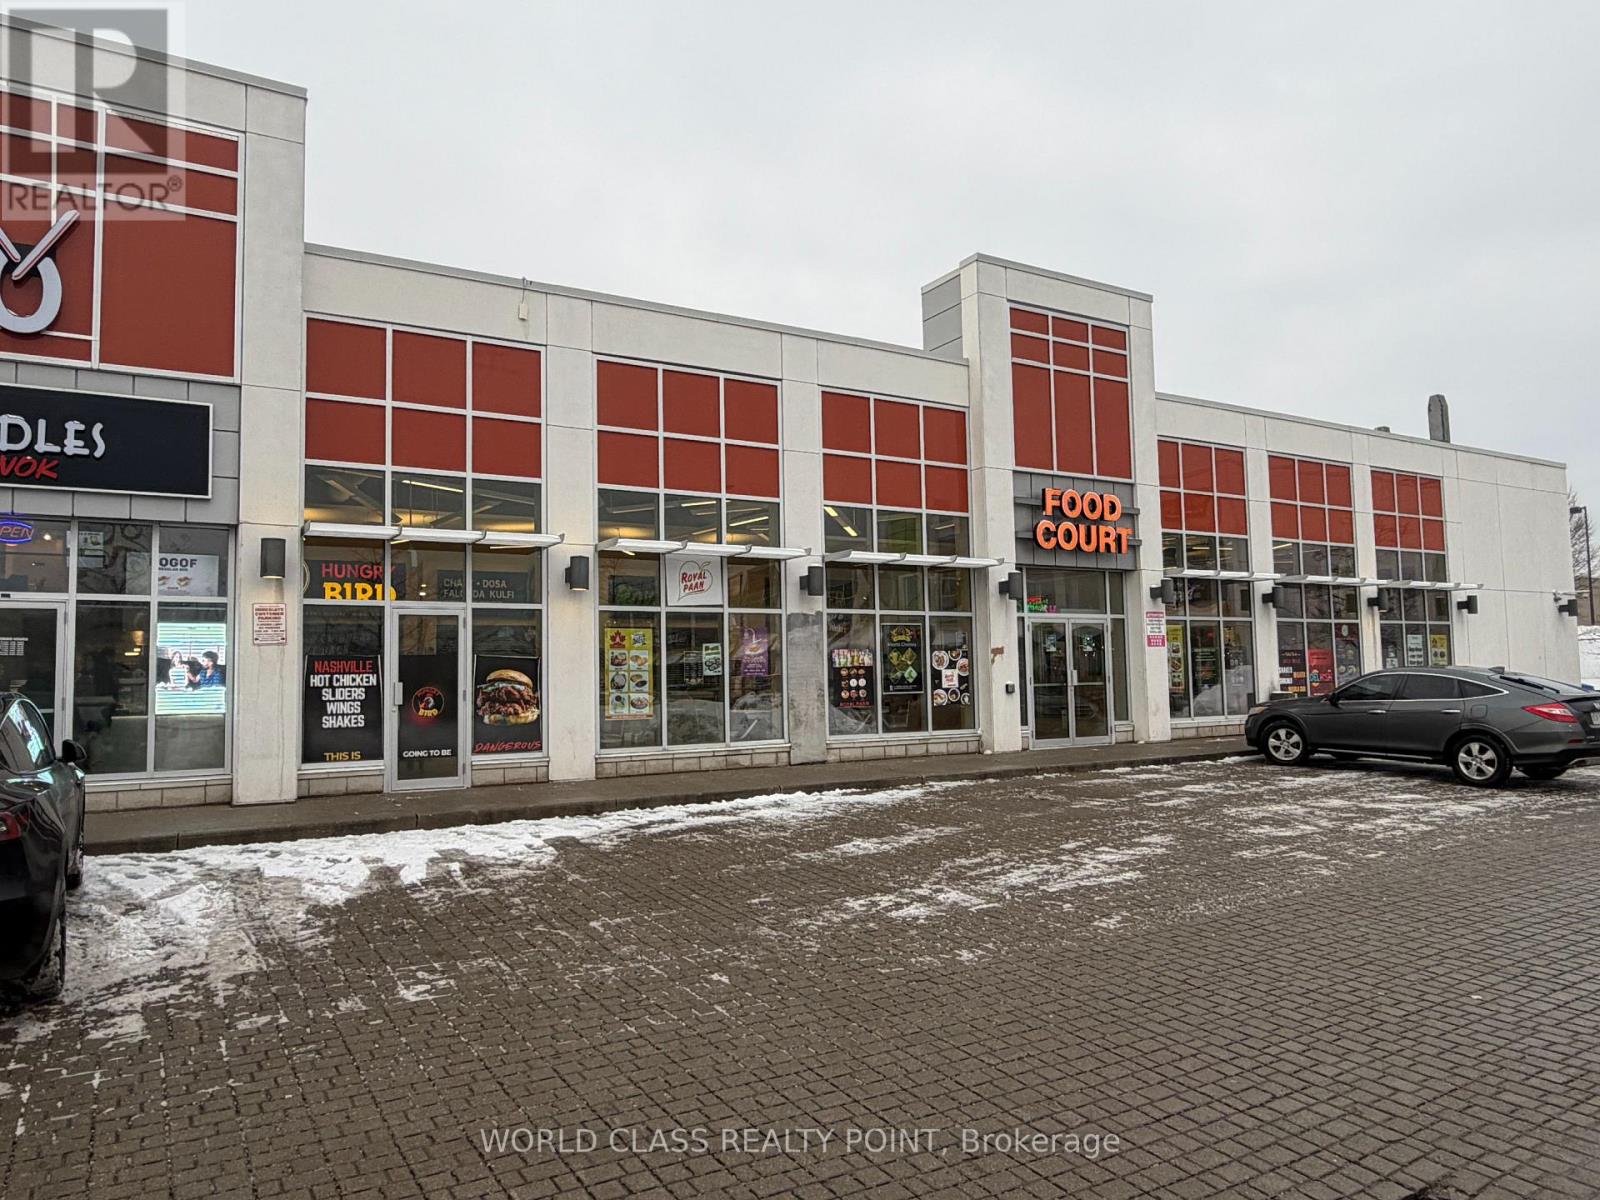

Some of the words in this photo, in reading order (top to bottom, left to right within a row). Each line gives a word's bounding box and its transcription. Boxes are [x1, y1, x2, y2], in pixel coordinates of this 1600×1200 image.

[1043, 488, 1122, 522] FOOD
[1035, 519, 1133, 555] COURT
[321, 563, 397, 579] HUNGR
[482, 579, 507, 588] DOSA
[681, 572, 708, 584] ROYAL
[682, 583, 705, 593] PAAN
[314, 660, 373, 673] NASHVILLE
[310, 674, 331, 688] HOT
[332, 674, 377, 687] CHICKEN
[321, 687, 366, 701] SLIDERS
[326, 701, 361, 714] WINGS
[321, 715, 365, 729] SHAKES
[474, 741, 542, 752] DANGEROUS
[323, 752, 351, 761] THIS
[351, 751, 361, 760] IS
[402, 750, 428, 758] GOING
[441, 749, 452, 757] BE
